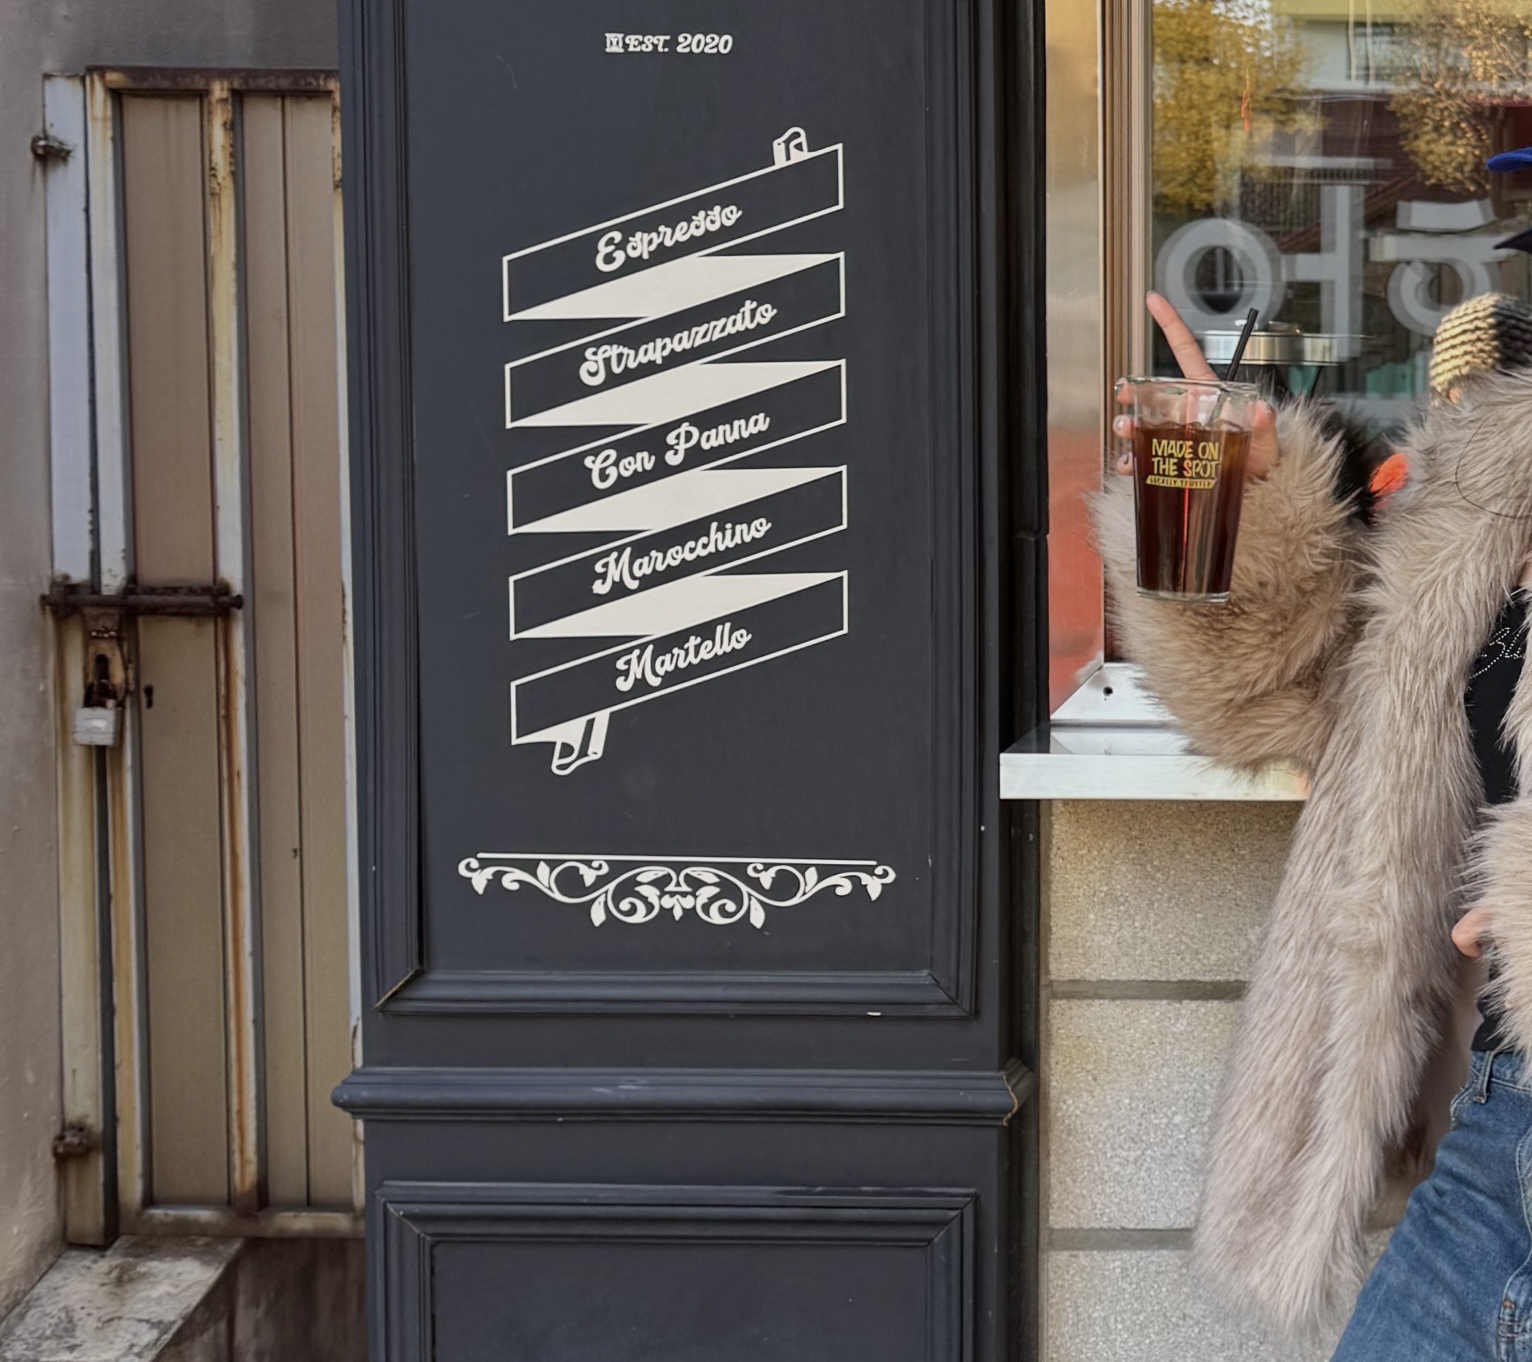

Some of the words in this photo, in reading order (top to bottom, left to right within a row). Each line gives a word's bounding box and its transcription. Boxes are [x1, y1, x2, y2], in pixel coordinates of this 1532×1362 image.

[624, 34, 671, 53] EST.
[675, 32, 733, 54] 2020
[595, 205, 743, 273] Espresso
[578, 299, 778, 387] Strapazzato
[583, 448, 656, 490] Con
[664, 412, 771, 466] Panna
[1151, 438, 1194, 459] MADE
[1197, 441, 1219, 460] ON
[1151, 457, 1178, 476] THE
[1183, 459, 1219, 478] SPOT
[591, 517, 772, 595] Marocchino
[615, 621, 753, 692] Martello
